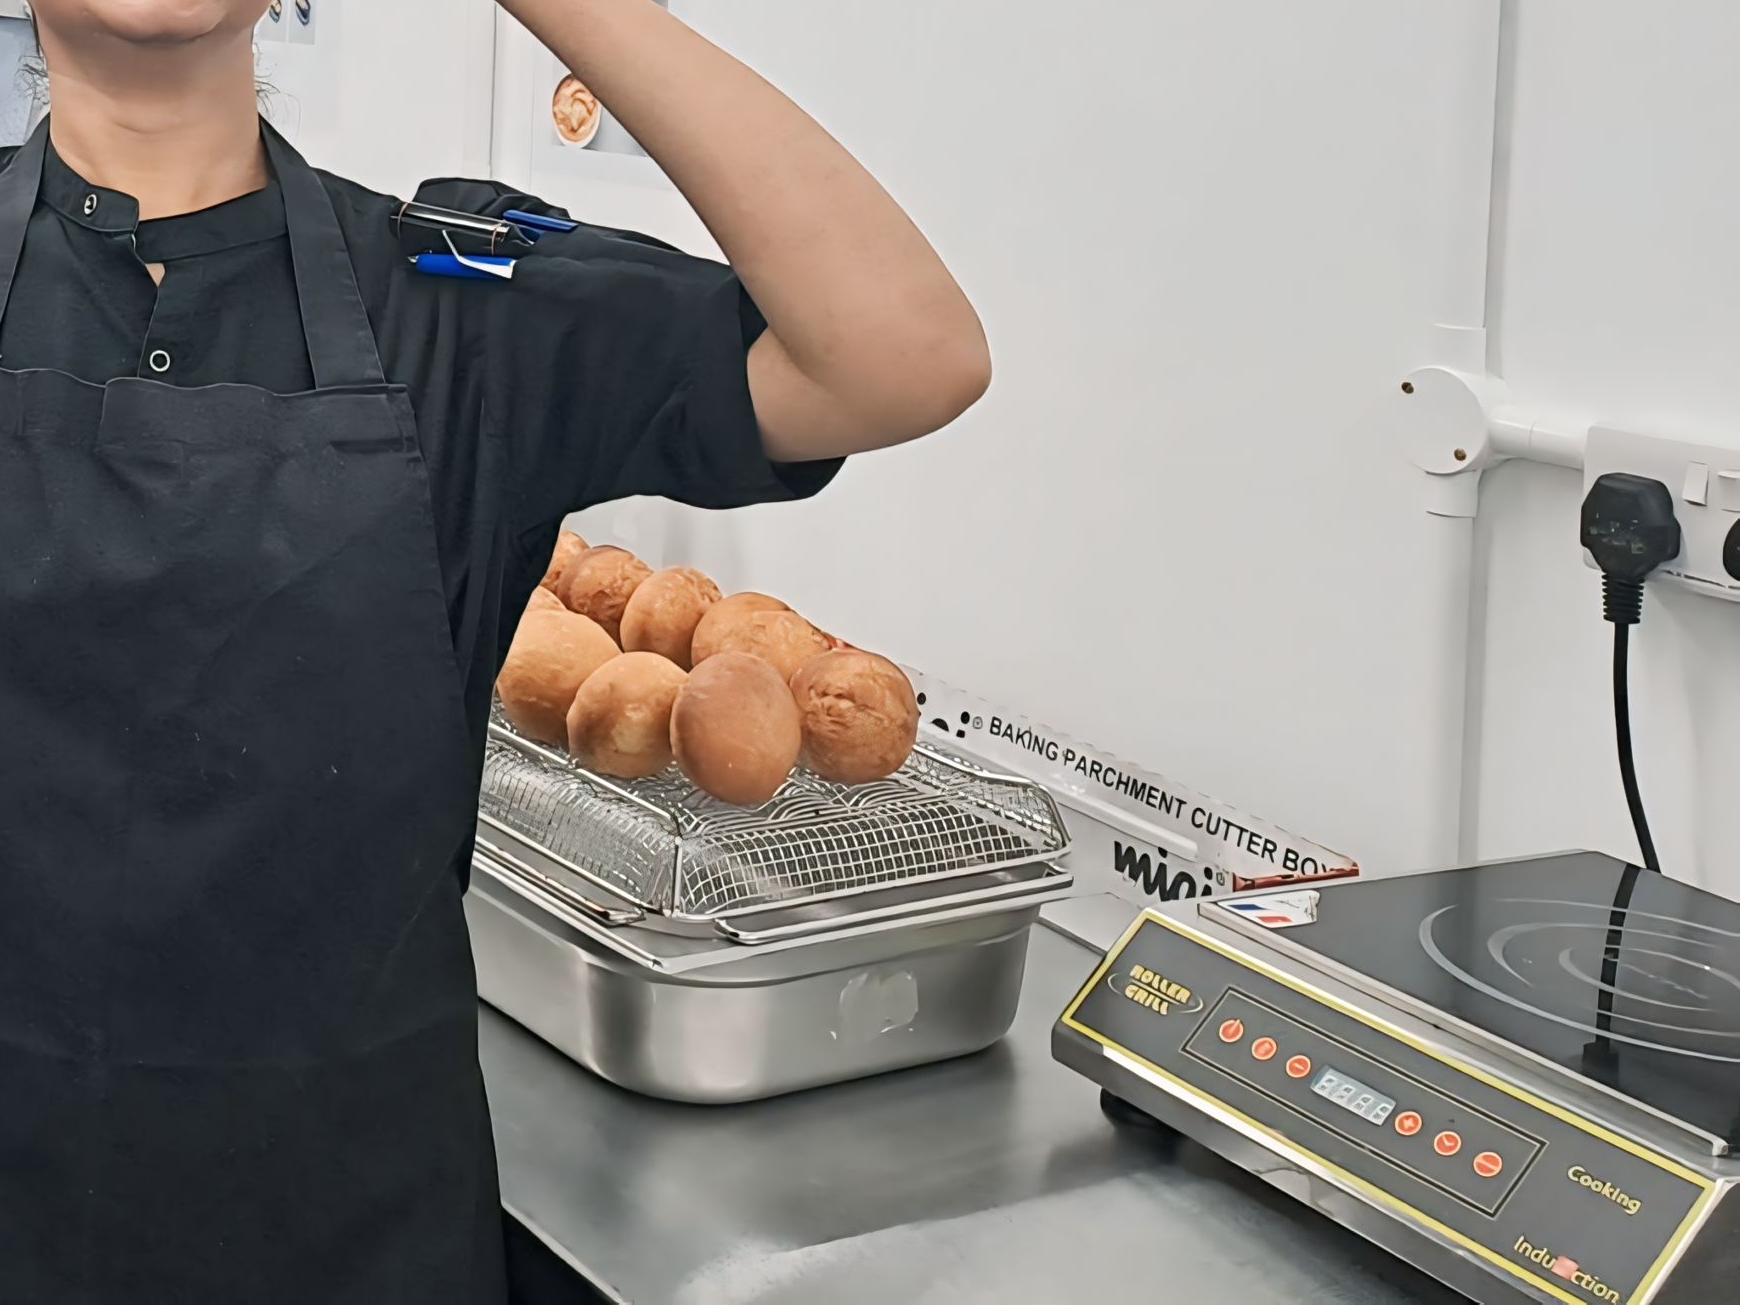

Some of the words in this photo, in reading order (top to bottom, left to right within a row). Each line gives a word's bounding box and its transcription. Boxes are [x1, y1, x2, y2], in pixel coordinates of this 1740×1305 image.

[989, 716, 1059, 761] BAKING
[1063, 747, 1188, 820] PARCHMENT
[1190, 806, 1279, 864] CUTTER
[1282, 847, 1331, 875] BO
[1566, 1164, 1642, 1215] Cooking
